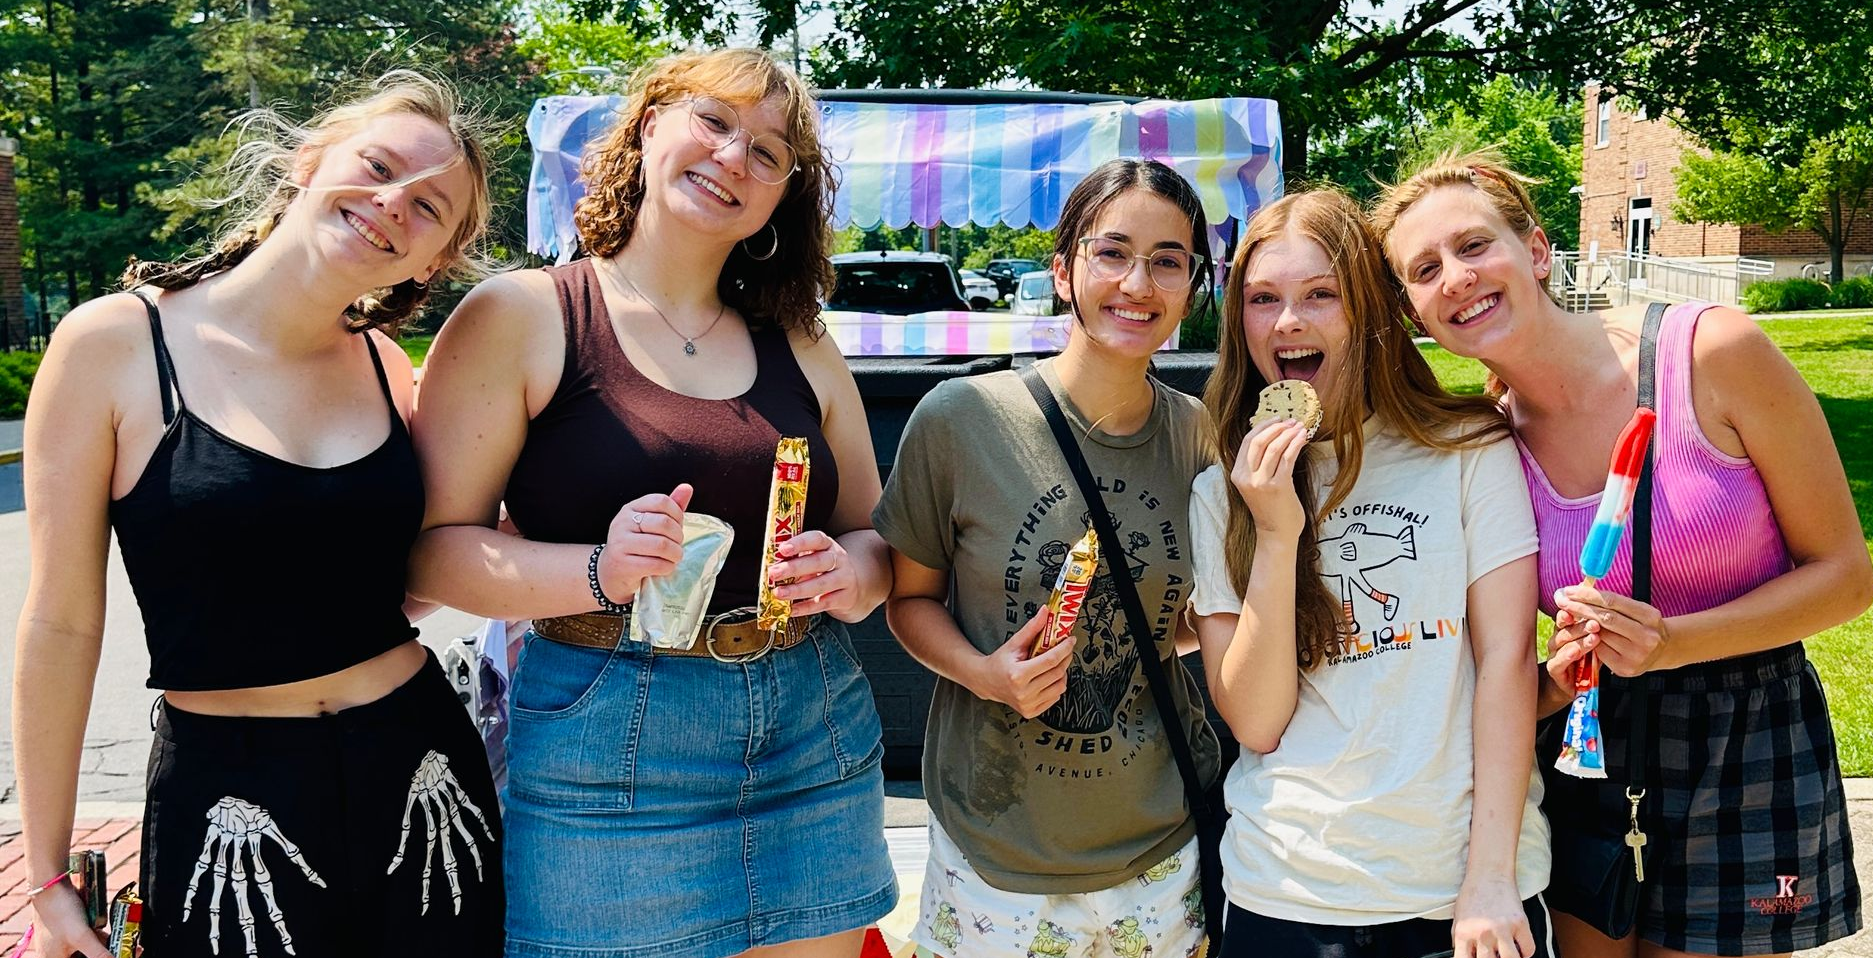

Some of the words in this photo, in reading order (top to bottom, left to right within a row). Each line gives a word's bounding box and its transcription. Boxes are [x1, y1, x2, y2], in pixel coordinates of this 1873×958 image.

[1096, 476, 1126, 494] LD
[1159, 520, 1180, 561] NEW
[1352, 504, 1429, 529] OFFISHAL!
[1056, 577, 1092, 639] TWIX
[1328, 650, 1374, 667] KALAMAZOO
[1376, 642, 1412, 655] COLLEGE
[1776, 875, 1799, 898] K
[1750, 894, 1813, 908] KALAMAZOO
[1760, 905, 1803, 915] COLLEGE
